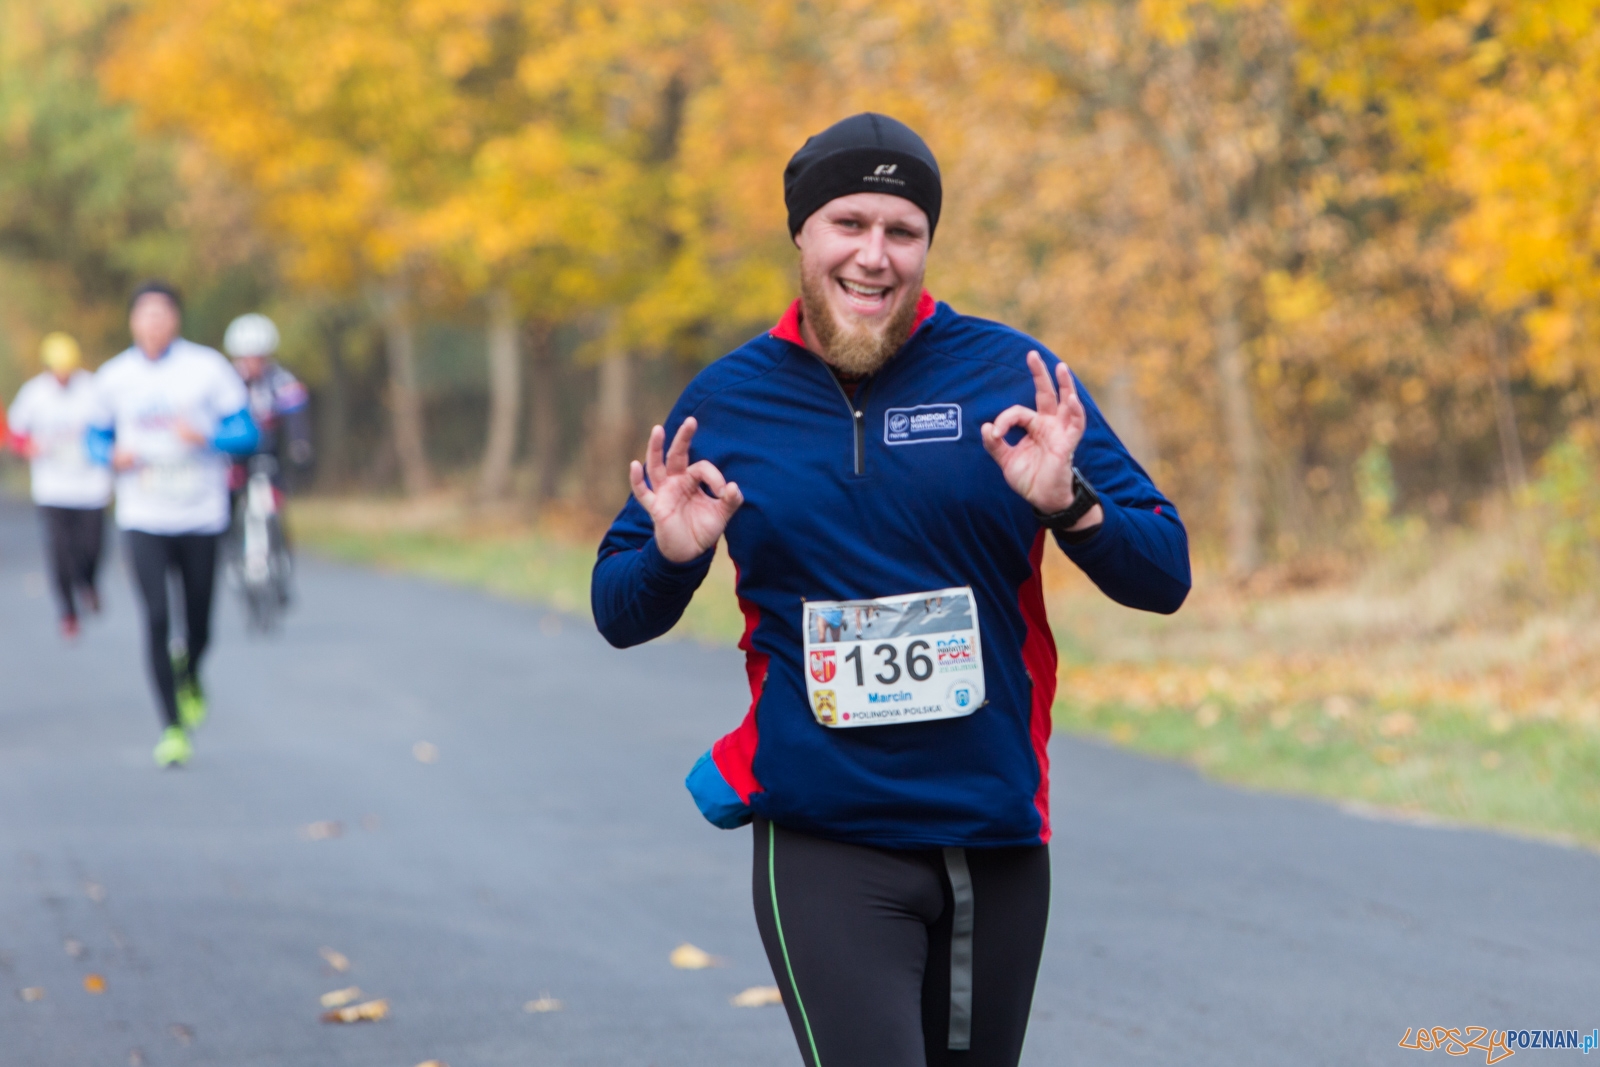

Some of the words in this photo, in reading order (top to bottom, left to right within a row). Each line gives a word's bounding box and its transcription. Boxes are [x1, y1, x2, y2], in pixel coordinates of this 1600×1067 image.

[910, 413, 947, 423] LONDON
[844, 639, 933, 687] 136
[868, 690, 913, 703] Marcin
[903, 704, 942, 716] POLSKA
